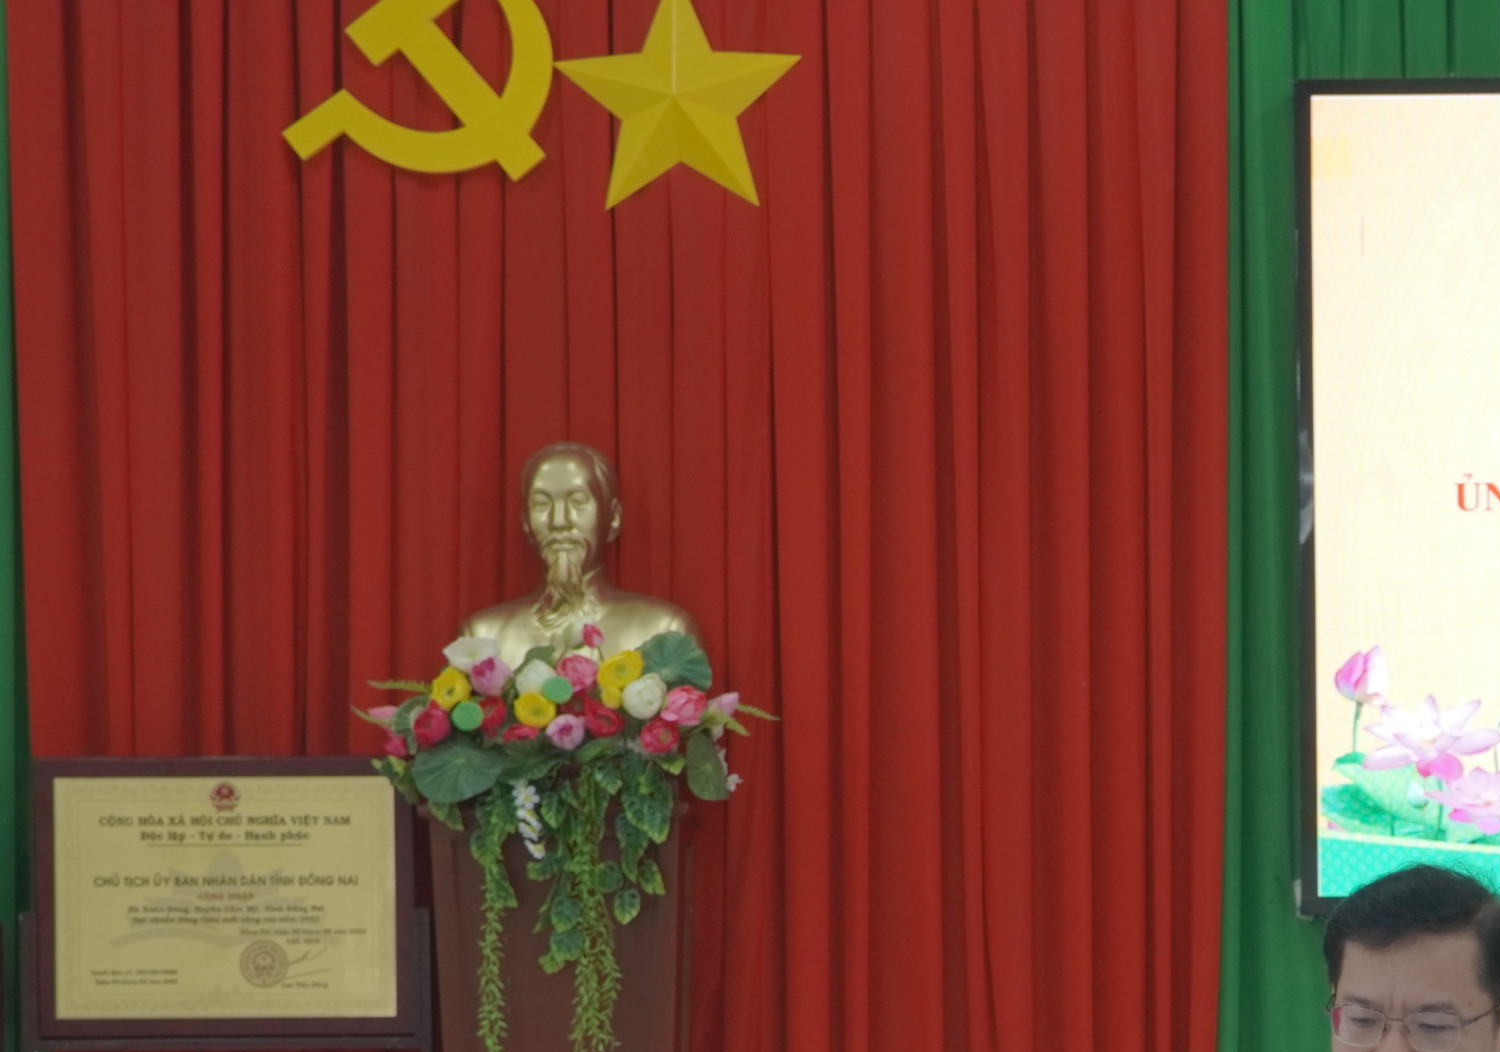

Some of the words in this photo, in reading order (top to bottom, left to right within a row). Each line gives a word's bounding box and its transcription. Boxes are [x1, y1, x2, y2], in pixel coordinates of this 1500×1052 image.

[322, 815, 351, 826] NAM
[174, 876, 199, 887] BAN
[337, 875, 359, 887] NAI
